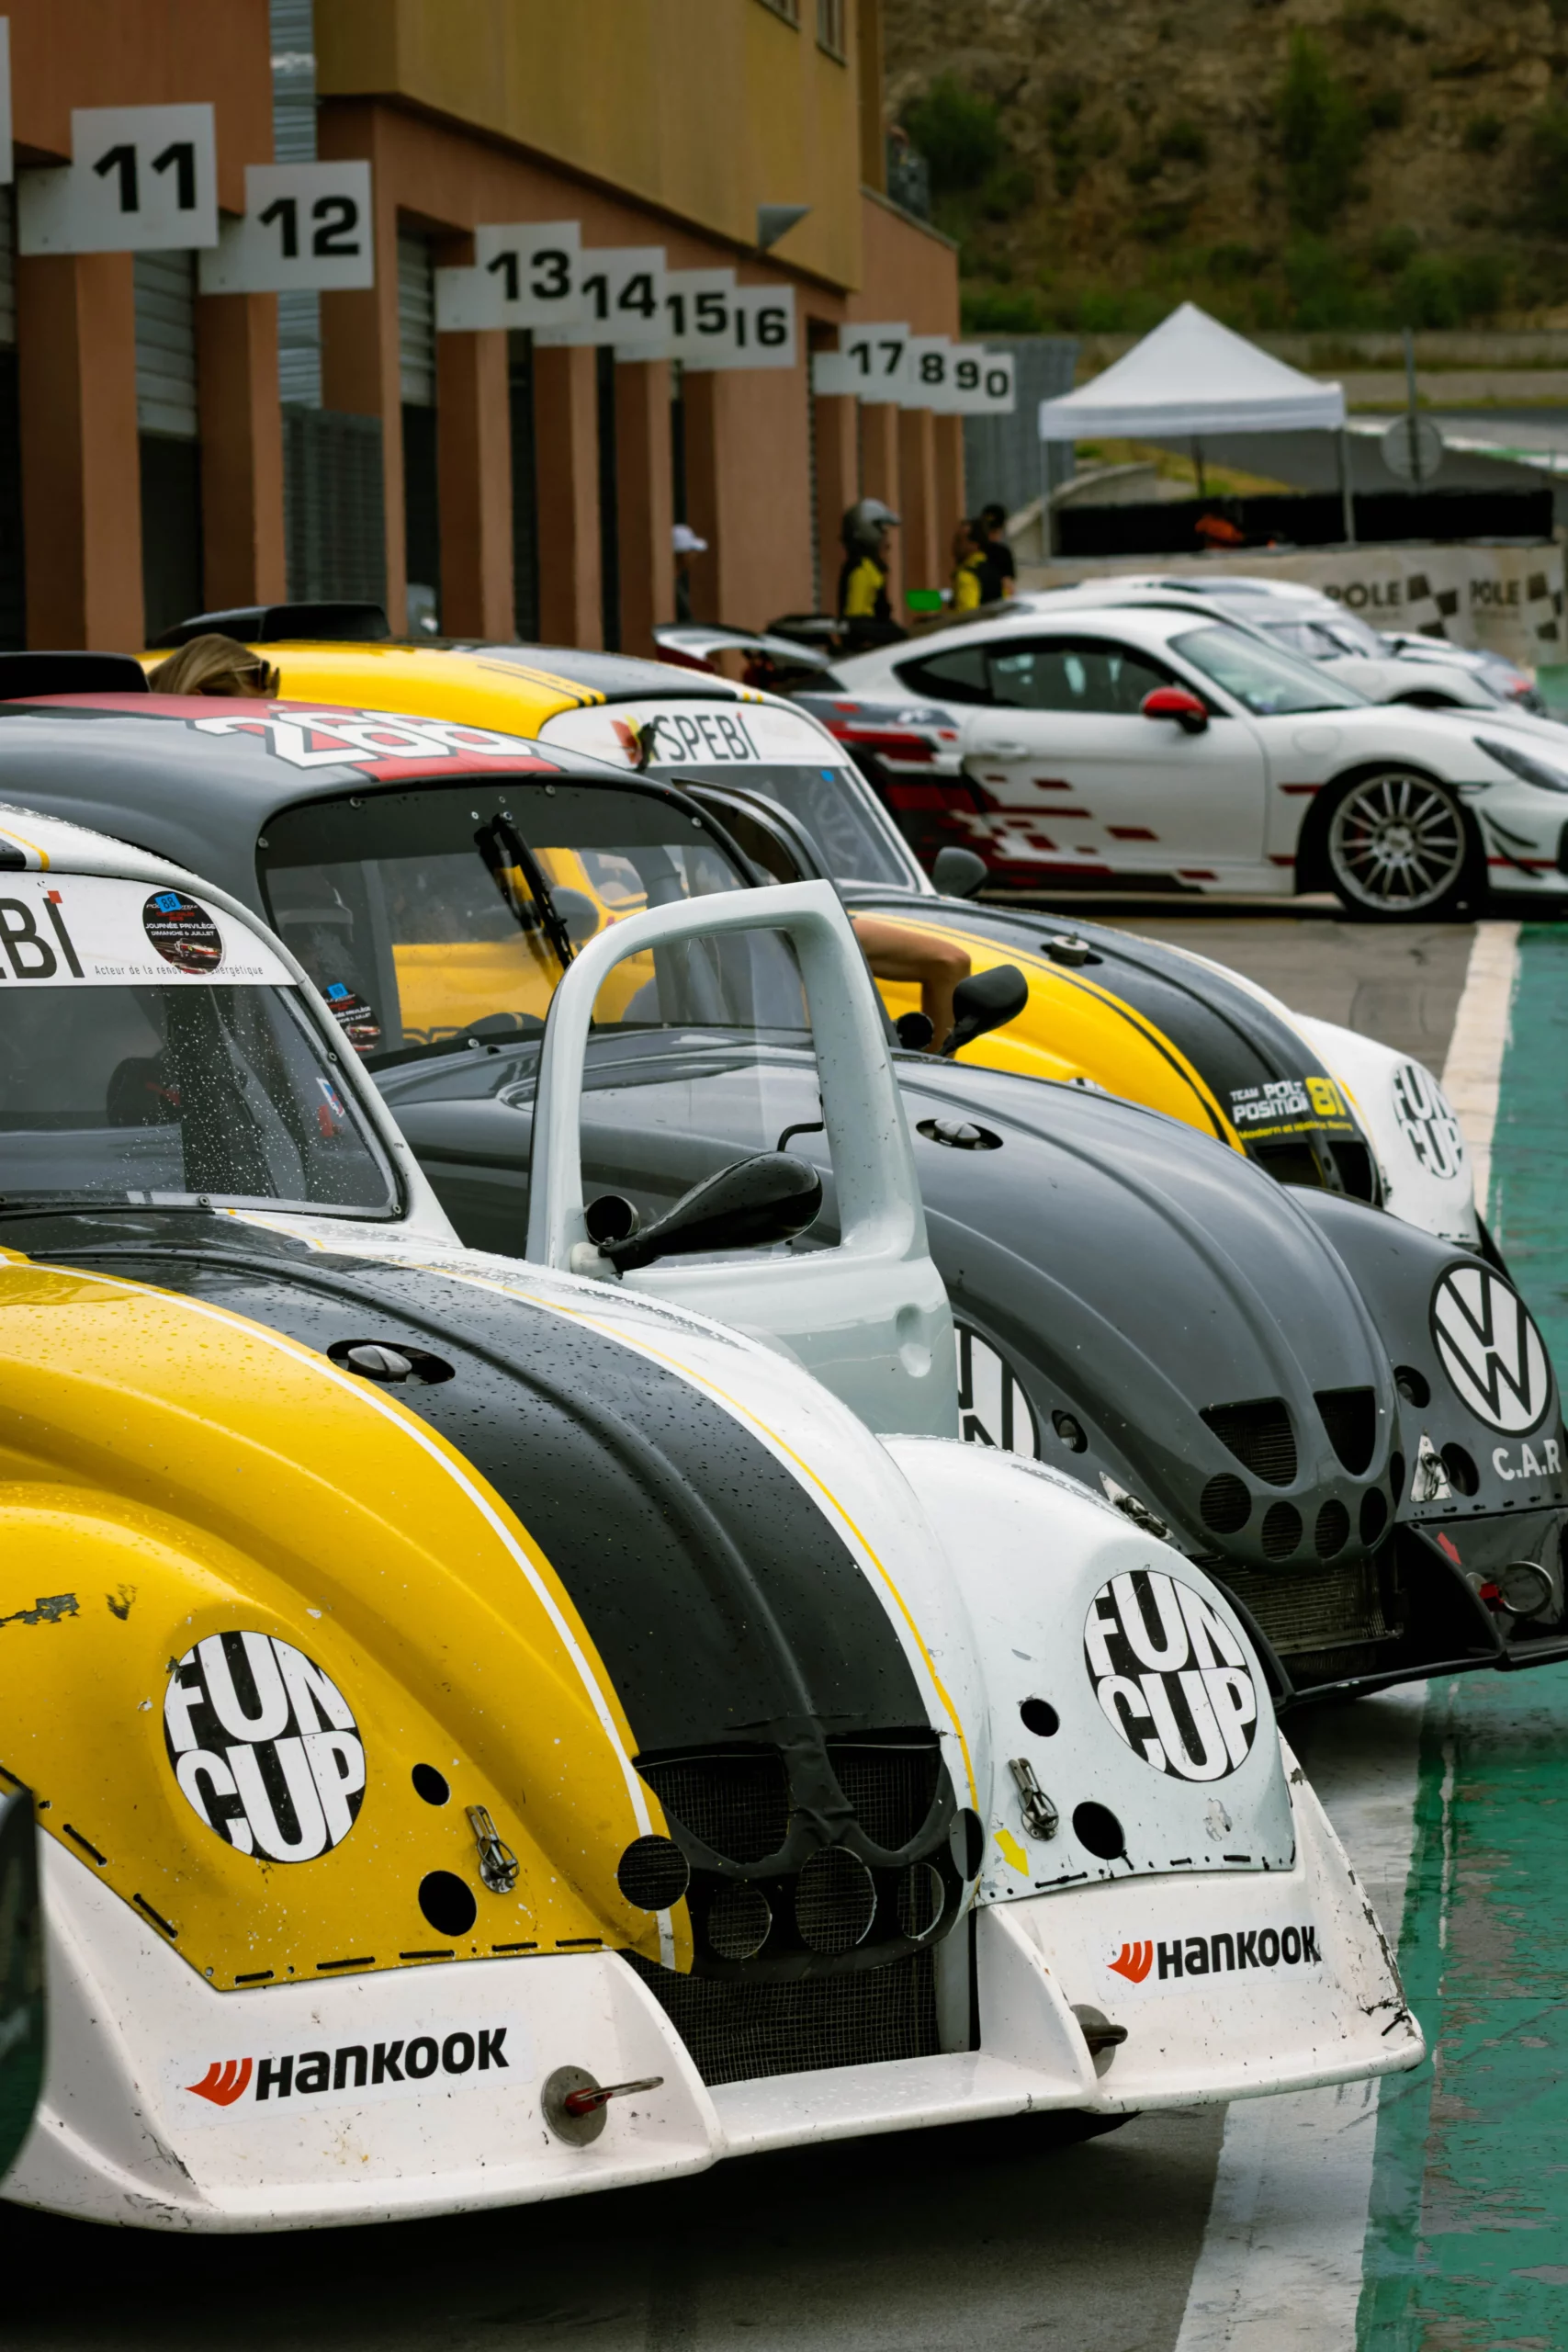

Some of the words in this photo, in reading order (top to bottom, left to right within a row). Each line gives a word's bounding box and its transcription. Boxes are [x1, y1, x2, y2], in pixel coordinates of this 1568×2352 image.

[93, 142, 197, 213] 11
[257, 196, 360, 258] 12
[487, 250, 571, 301] 13
[581, 273, 657, 321] 14
[666, 291, 728, 336] 15
[849, 340, 905, 376] 17
[1323, 581, 1401, 608] POLE
[161, 897, 176, 909] 88
[0, 890, 85, 979] BI
[95, 965, 125, 975] Acteur
[130, 965, 141, 975] de
[143, 965, 152, 975] la
[157, 965, 182, 975] rénov
[1230, 1088, 1259, 1102] TEAM
[1305, 1076, 1346, 1116] 81
[1392, 1063, 1456, 1121] FUN
[1401, 1116, 1462, 1180] CUP
[1084, 1570, 1247, 1678] FUN
[164, 1631, 356, 1753] FUN
[1097, 1667, 1257, 1781] CUP
[176, 1730, 366, 1862] CUP
